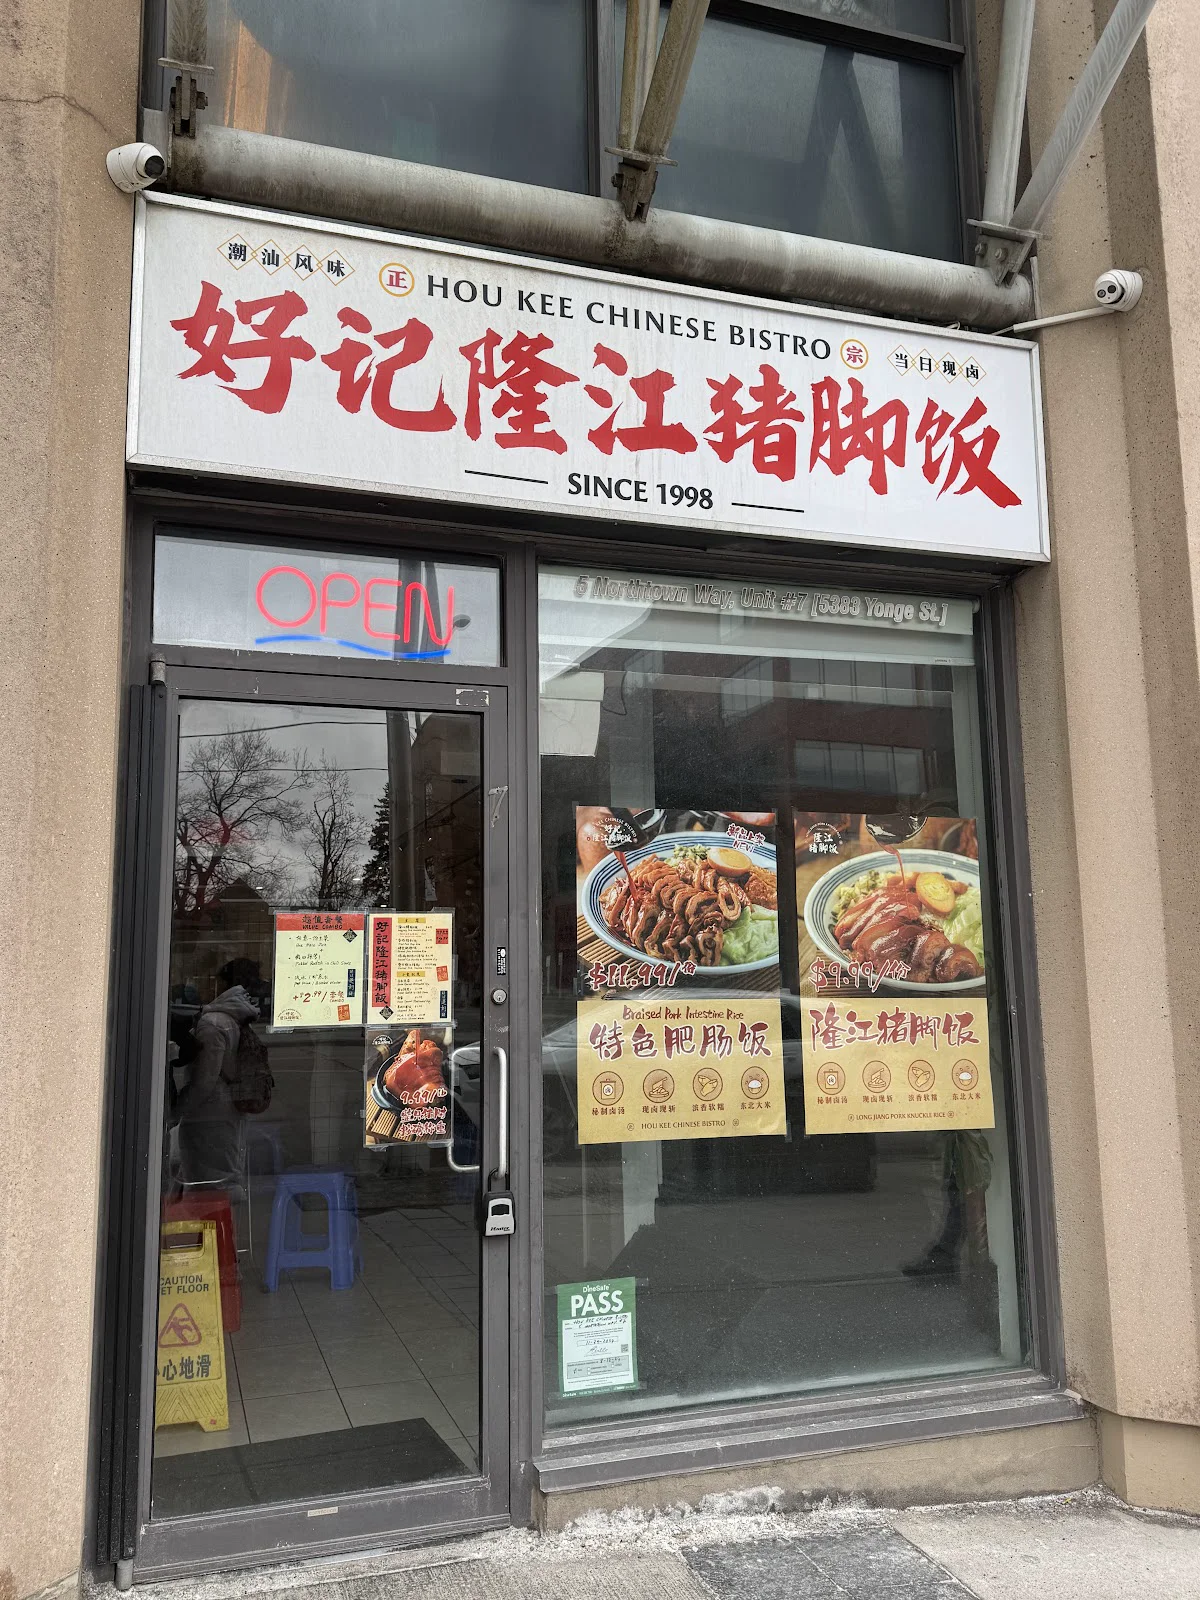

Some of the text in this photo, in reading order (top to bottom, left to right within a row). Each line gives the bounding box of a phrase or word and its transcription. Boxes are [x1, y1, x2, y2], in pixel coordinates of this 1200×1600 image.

[228, 242, 346, 278] 潮汕风味
[386, 270, 408, 290] 正
[427, 275, 831, 360] HOU KEE CHINESE BISTRO
[894, 353, 980, 381] 当日现卤
[170, 281, 1022, 508] 好记隆江猪脚饭
[568, 473, 713, 510] SINCE 1998
[256, 566, 455, 646] OPEN
[574, 575, 590, 596] 5
[593, 575, 688, 603] Northtown
[694, 584, 734, 610] Way,
[740, 588, 776, 610] Unit
[780, 592, 808, 612] #7
[865, 597, 915, 623] Yonge
[623, 1005, 744, 1020] Braised Pork Intestine Rice
[589, 1020, 772, 1061] 特色肥肠饭
[809, 1002, 981, 1052] 隆江猪脚饭
[740, 1101, 771, 1110] 东北大米
[952, 1092, 981, 1100] 东北大米
[160, 1284, 209, 1295] ET FLOOR
[582, 1284, 610, 1293] DineSafe
[571, 1290, 624, 1317] PASS
[157, 1354, 211, 1381] 心地滑
